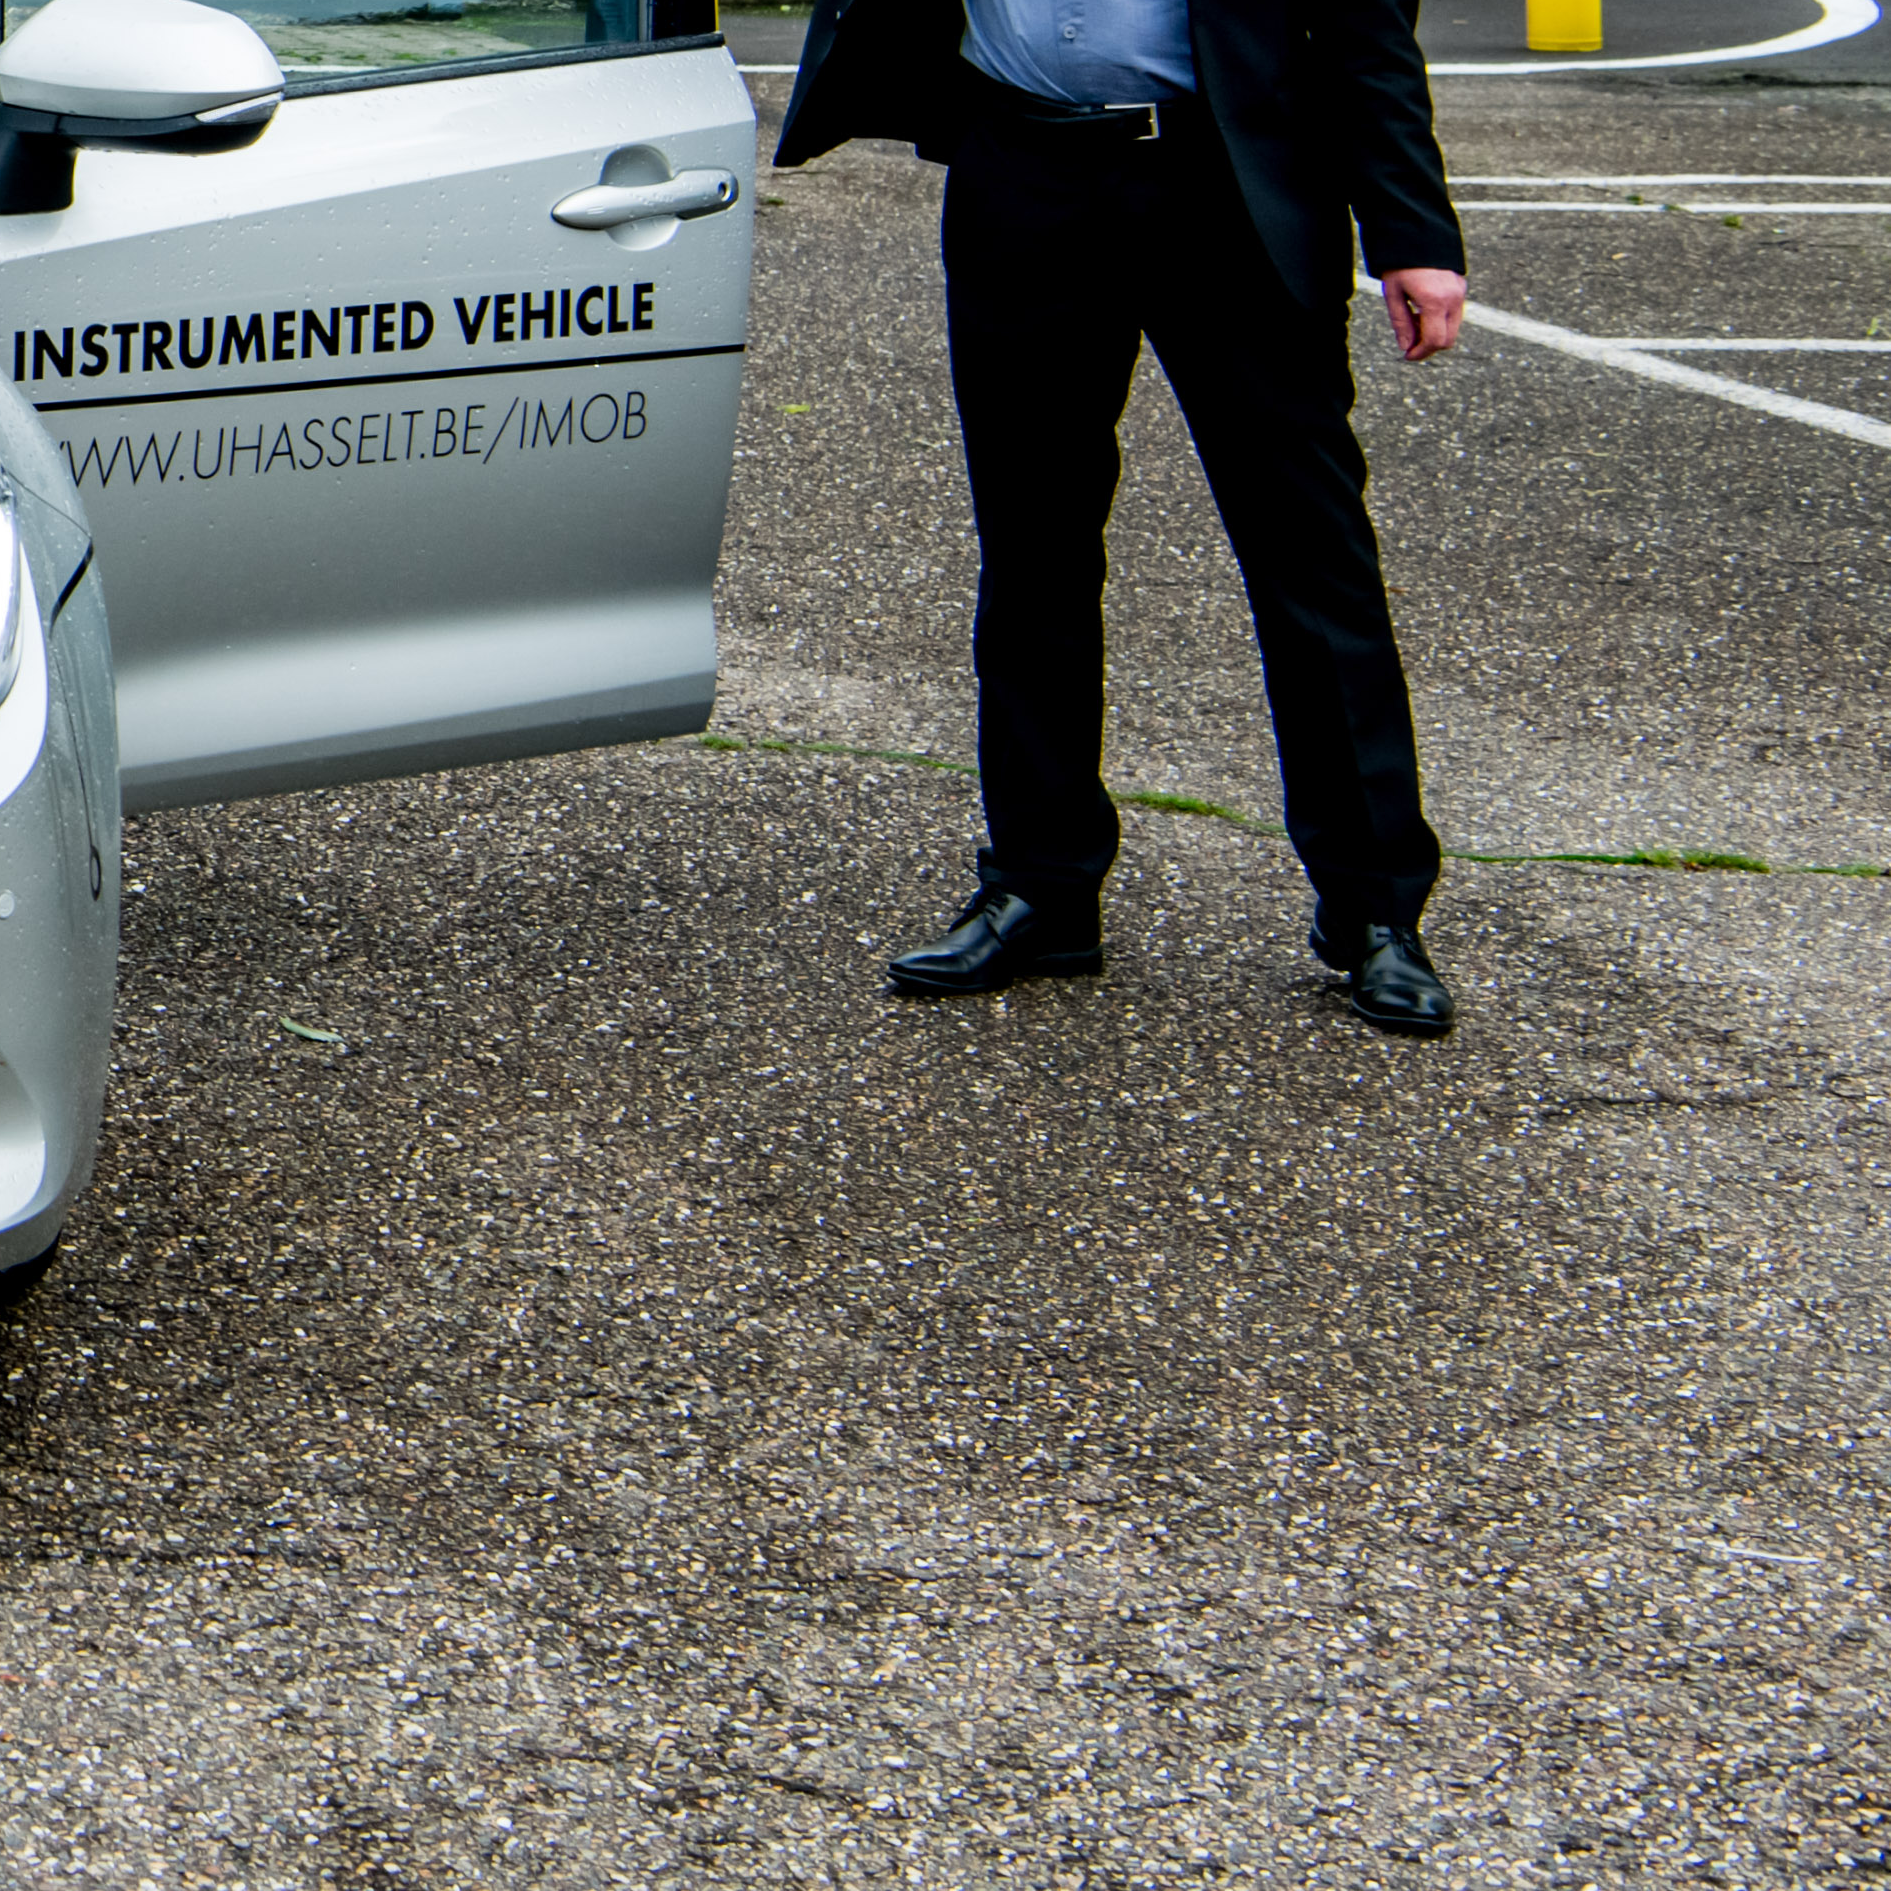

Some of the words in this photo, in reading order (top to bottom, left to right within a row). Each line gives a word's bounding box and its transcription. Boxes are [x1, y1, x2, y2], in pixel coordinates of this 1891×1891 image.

[13, 299, 435, 382] INSTRUMENTED
[452, 282, 655, 346] VEHICLE
[59, 390, 649, 489] WW.UHASSELT.BE/IMOB
